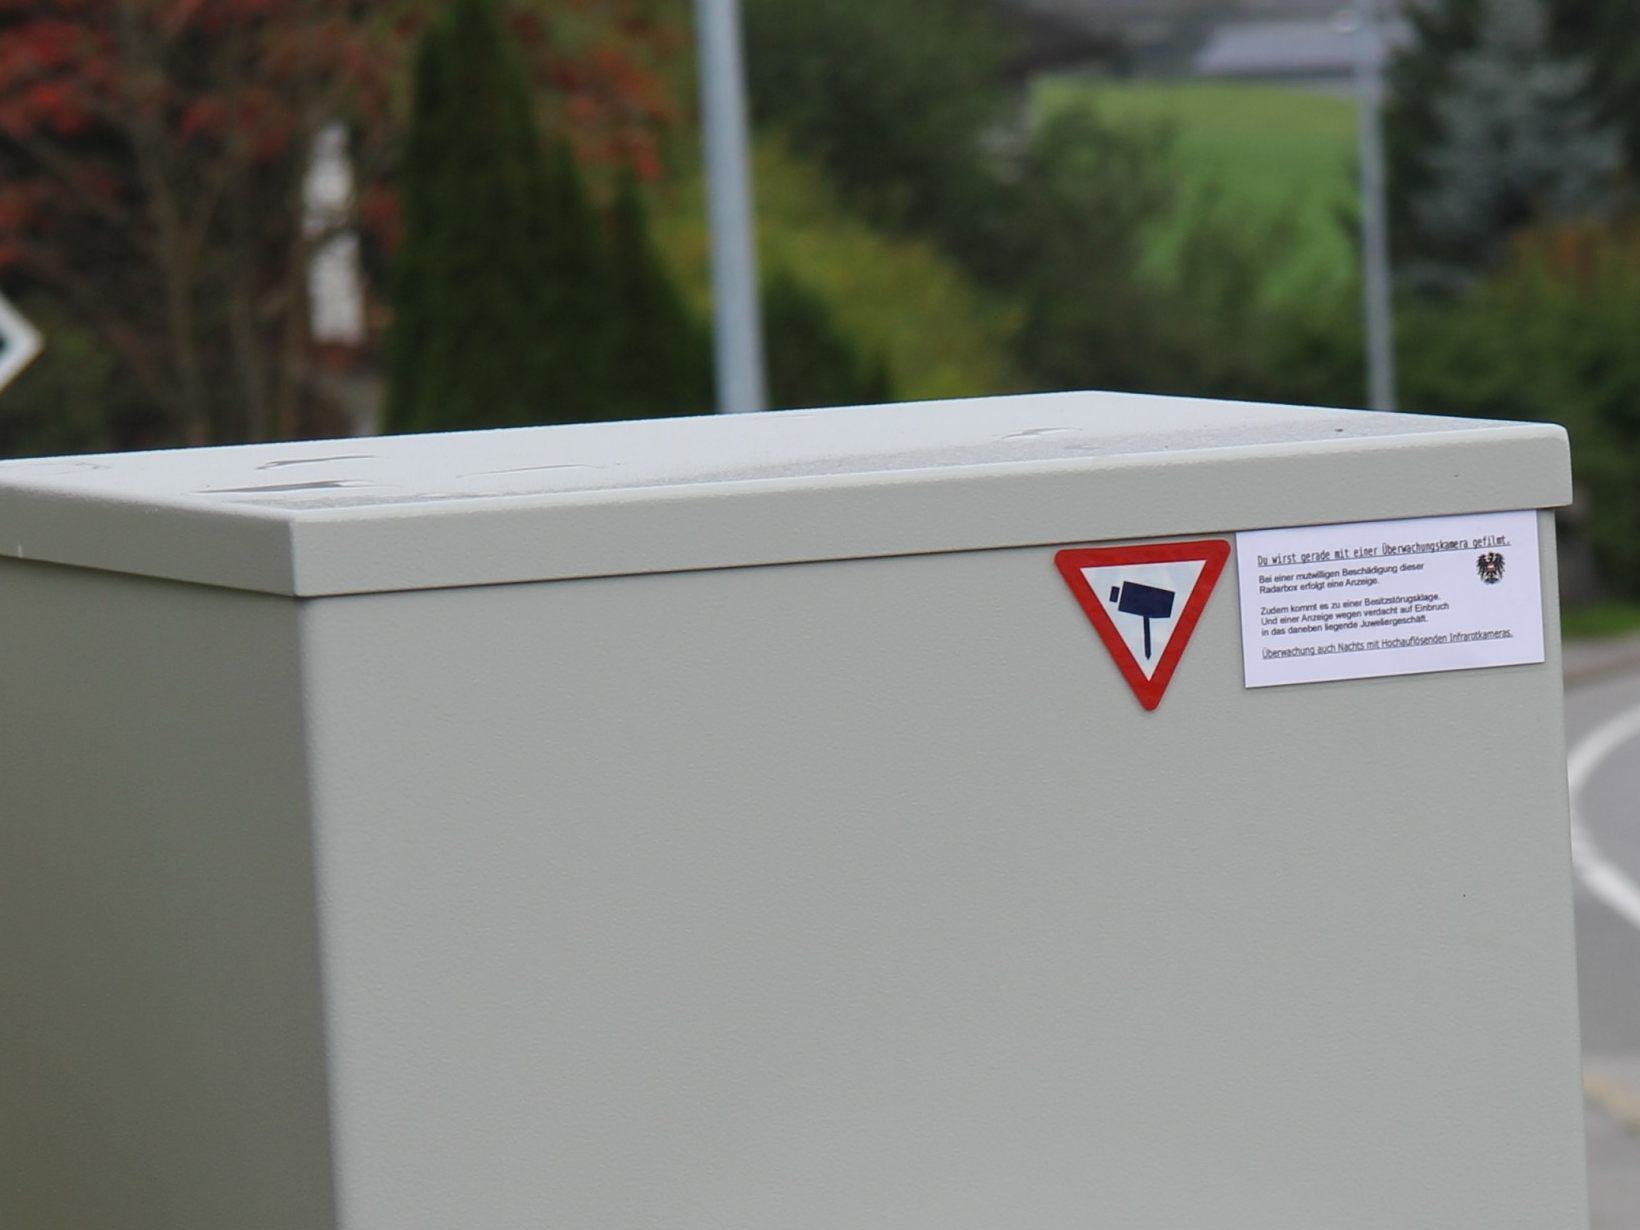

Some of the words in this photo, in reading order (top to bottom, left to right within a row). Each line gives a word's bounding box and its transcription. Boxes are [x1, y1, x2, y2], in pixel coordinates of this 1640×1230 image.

[1257, 554, 1268, 565] Du
[1271, 552, 1296, 563] wirst
[1301, 549, 1330, 563] gerade
[1334, 547, 1348, 558] mit
[1353, 546, 1378, 558] einer
[1382, 539, 1469, 555] Überwachungskamera
[1259, 575, 1272, 584] Bei
[1274, 573, 1294, 582] einer
[1296, 570, 1340, 580] mutwilligen
[1342, 565, 1398, 576] Beschädigung
[1400, 563, 1424, 571] dieser
[1259, 585, 1298, 594] Radarbox
[1300, 582, 1325, 591] erfolgt
[1327, 580, 1344, 588] eine
[1260, 606, 1289, 615] Zudem
[1291, 603, 1317, 612] kommt
[1342, 599, 1362, 608] einer
[1261, 616, 1278, 625] Und
[1280, 615, 1300, 624] einer
[1301, 613, 1333, 622] Anzeige
[1335, 610, 1362, 620] wegen
[1363, 606, 1398, 616] verdacht
[1400, 605, 1413, 613] auf
[1415, 602, 1449, 612] Einbruch
[1261, 628, 1269, 636] in
[1271, 626, 1286, 635] das
[1288, 624, 1322, 634] daneben
[1324, 621, 1358, 632] liegende
[1262, 645, 1316, 659] Überwachung
[1317, 643, 1336, 655] auch
[1337, 641, 1365, 652] Nachts
[1366, 640, 1379, 649] mit
